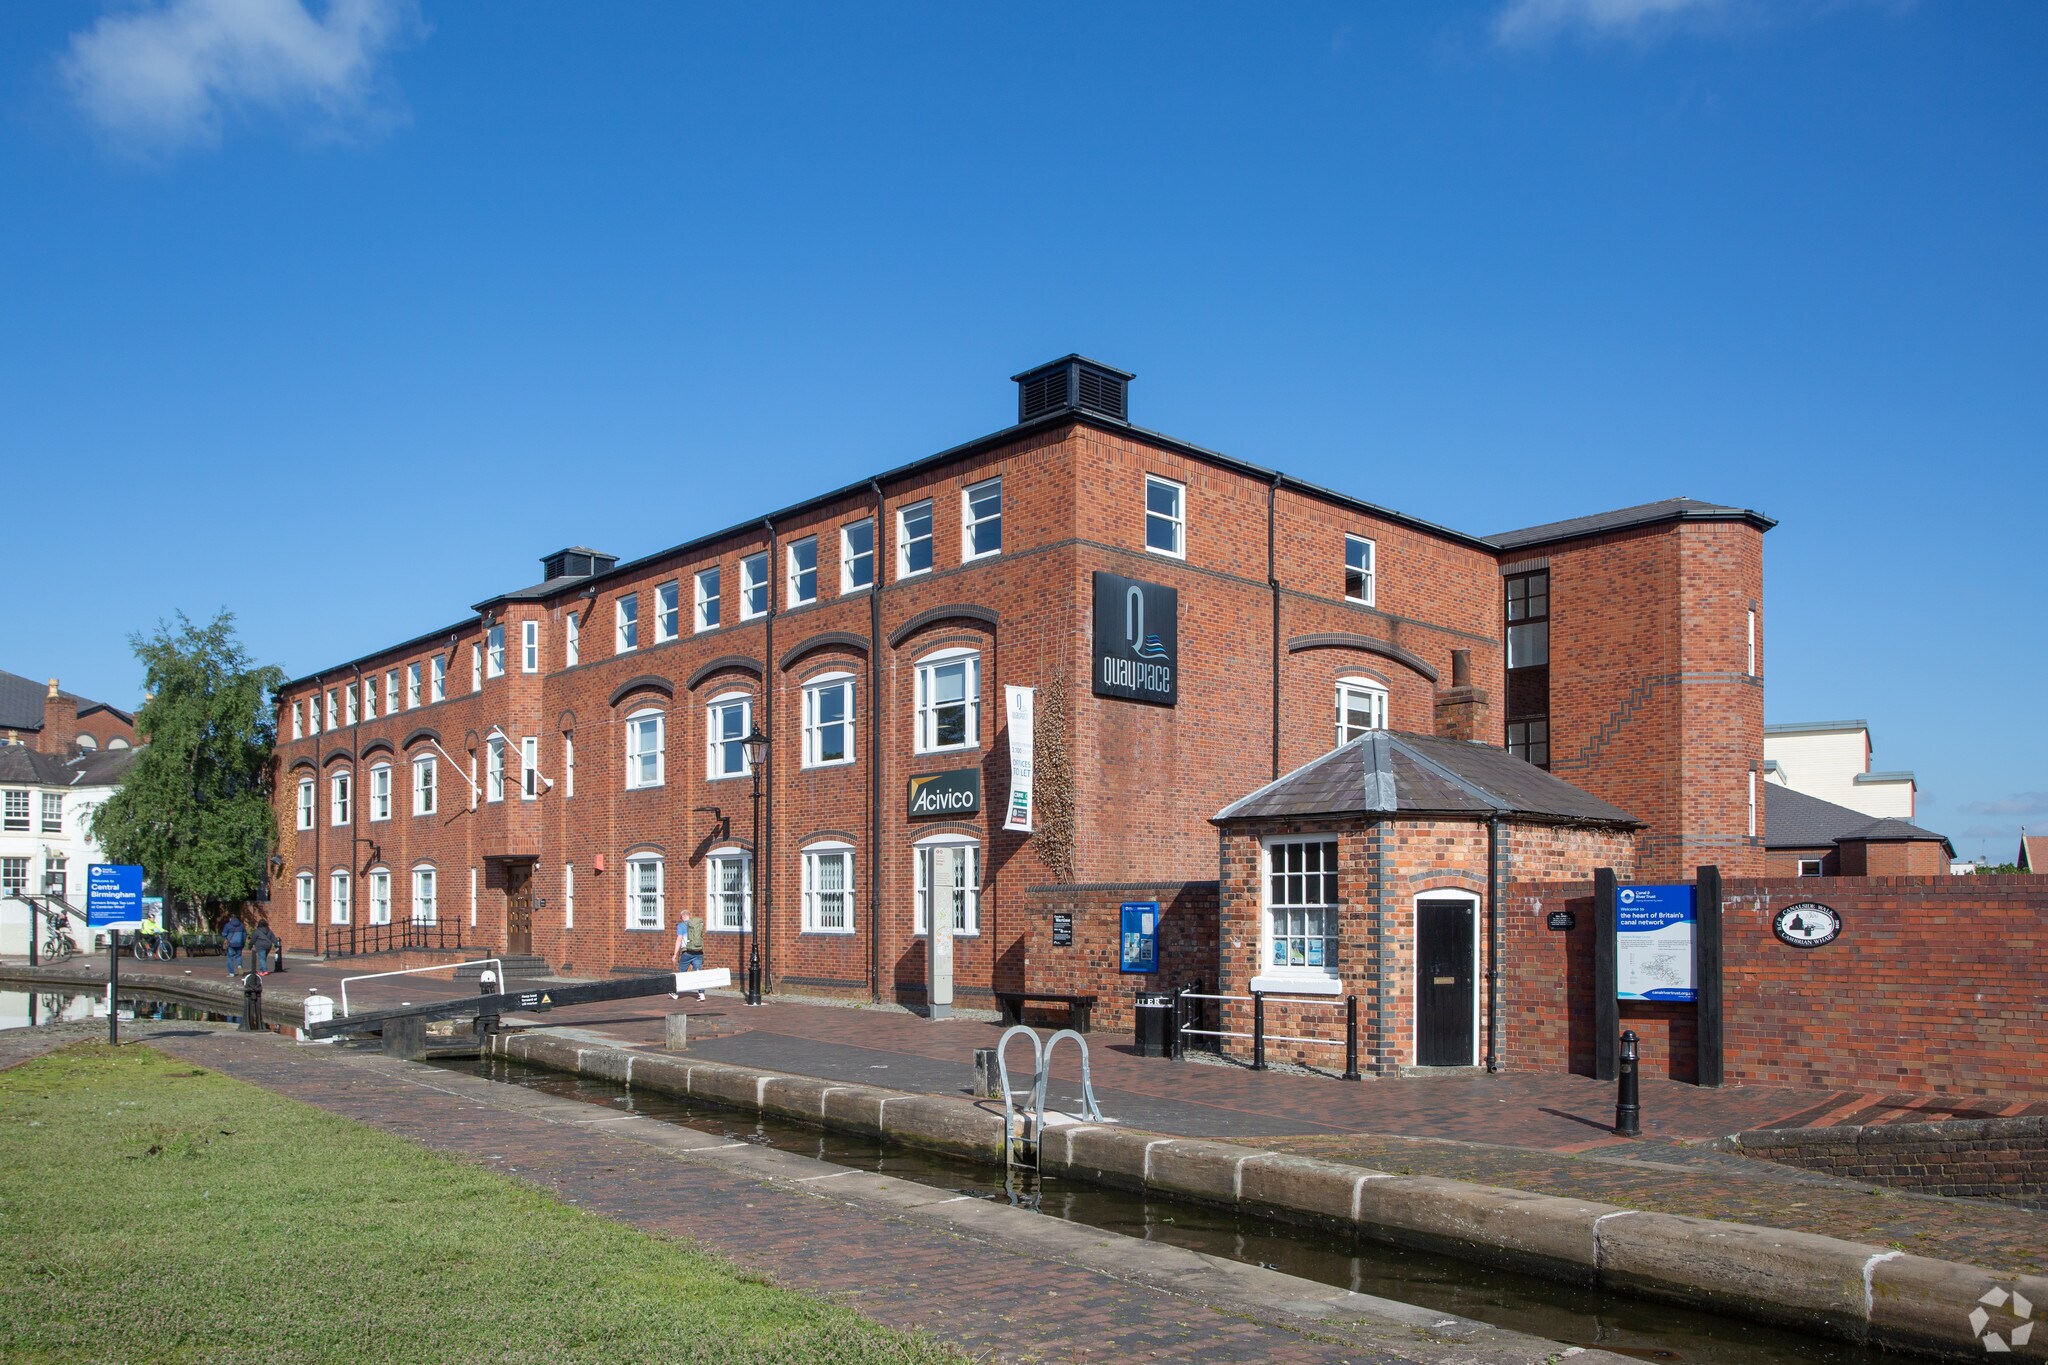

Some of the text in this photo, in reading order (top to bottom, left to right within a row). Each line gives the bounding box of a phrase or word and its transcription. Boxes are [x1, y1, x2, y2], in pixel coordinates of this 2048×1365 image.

[1012, 759, 1031, 768] OFFICES
[1013, 767, 1031, 777] TO LET
[912, 787, 974, 812] Acivico
[91, 891, 136, 899] Birmingham
[1783, 903, 1833, 916] CANALSIDE WALK
[1781, 932, 1835, 945] CAMBRIAN WHARF
